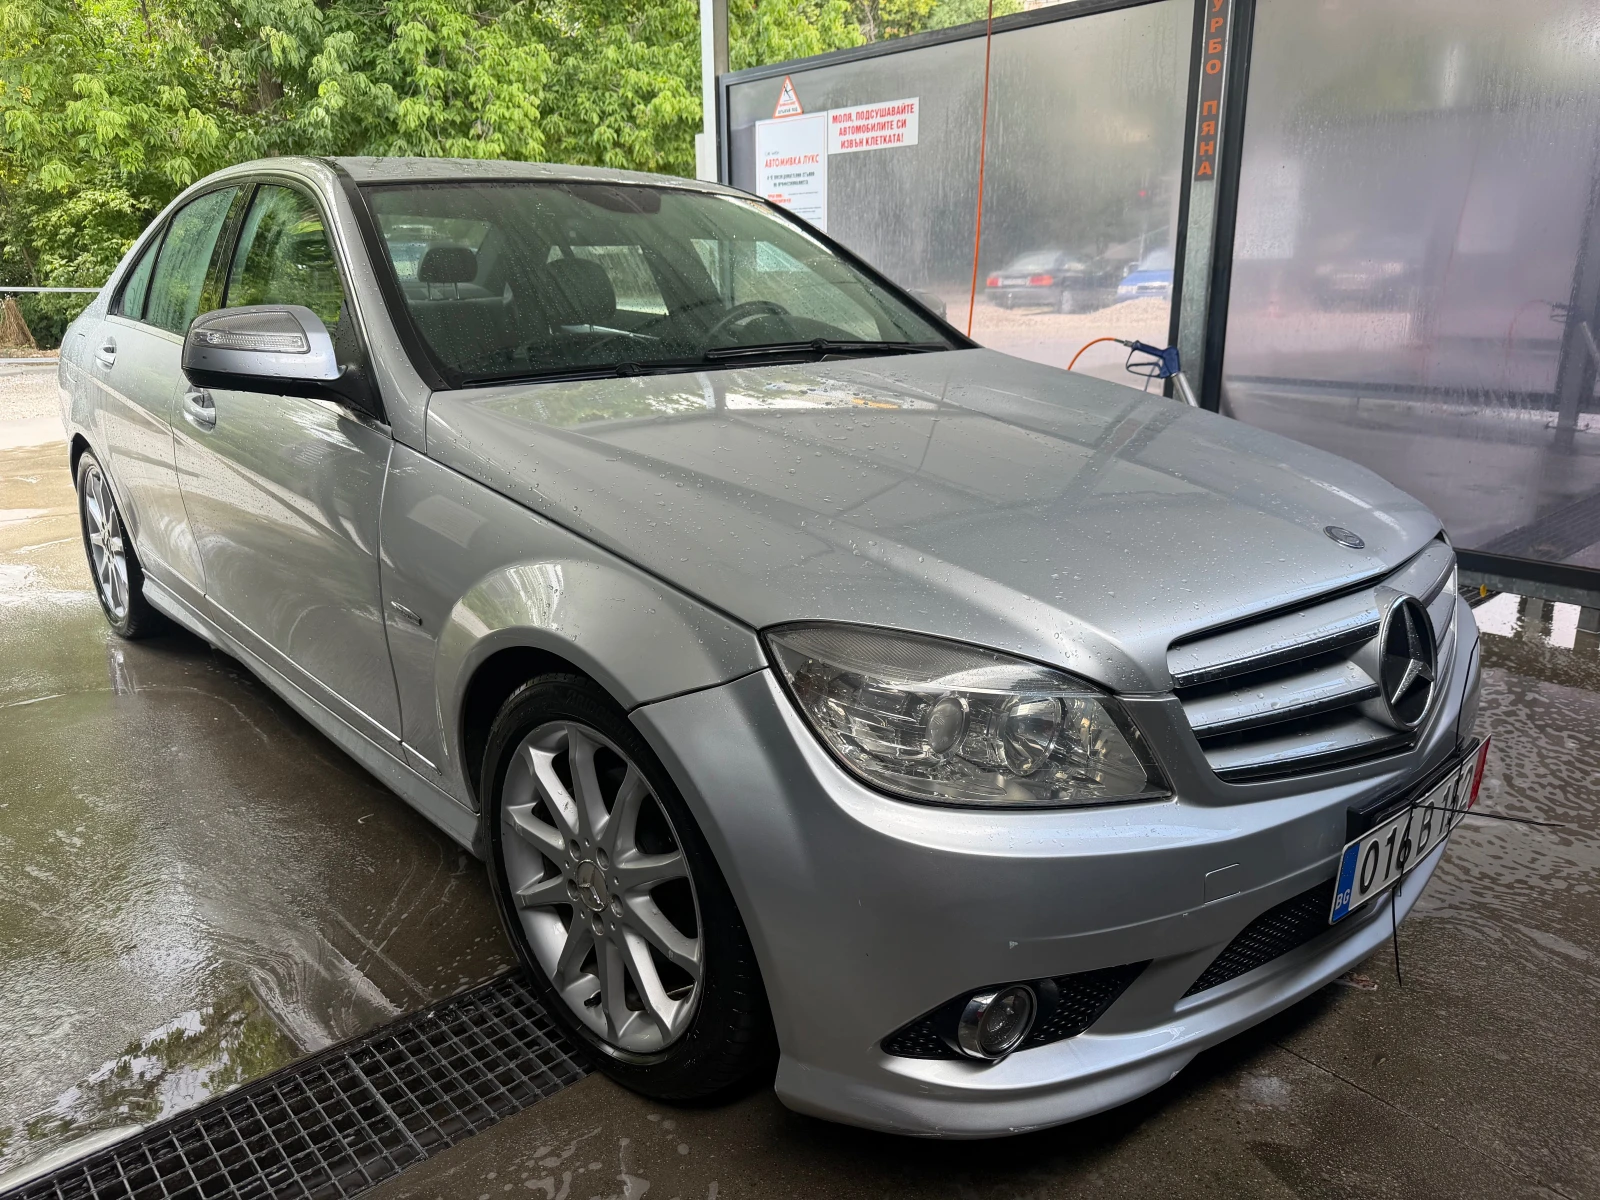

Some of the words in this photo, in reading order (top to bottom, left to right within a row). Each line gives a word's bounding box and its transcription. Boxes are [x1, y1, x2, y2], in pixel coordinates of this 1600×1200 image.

[832, 112, 854, 124] МОЛЯ,
[856, 102, 915, 121] ПОДСУШАВАЙТЕ
[839, 119, 894, 137] АВТОМОБИЛИТЕ
[896, 118, 907, 129] СИ
[1197, 100, 1218, 176] ПЯНА
[840, 138, 864, 149] ИЗВЪН
[865, 133, 904, 146] КЛЕТКАТА!
[765, 156, 802, 168] АВТОМИВКА
[803, 154, 820, 165] ЛУКС
[1359, 815, 1413, 896] 016
[1416, 799, 1435, 859] B
[1335, 888, 1350, 910] BG
